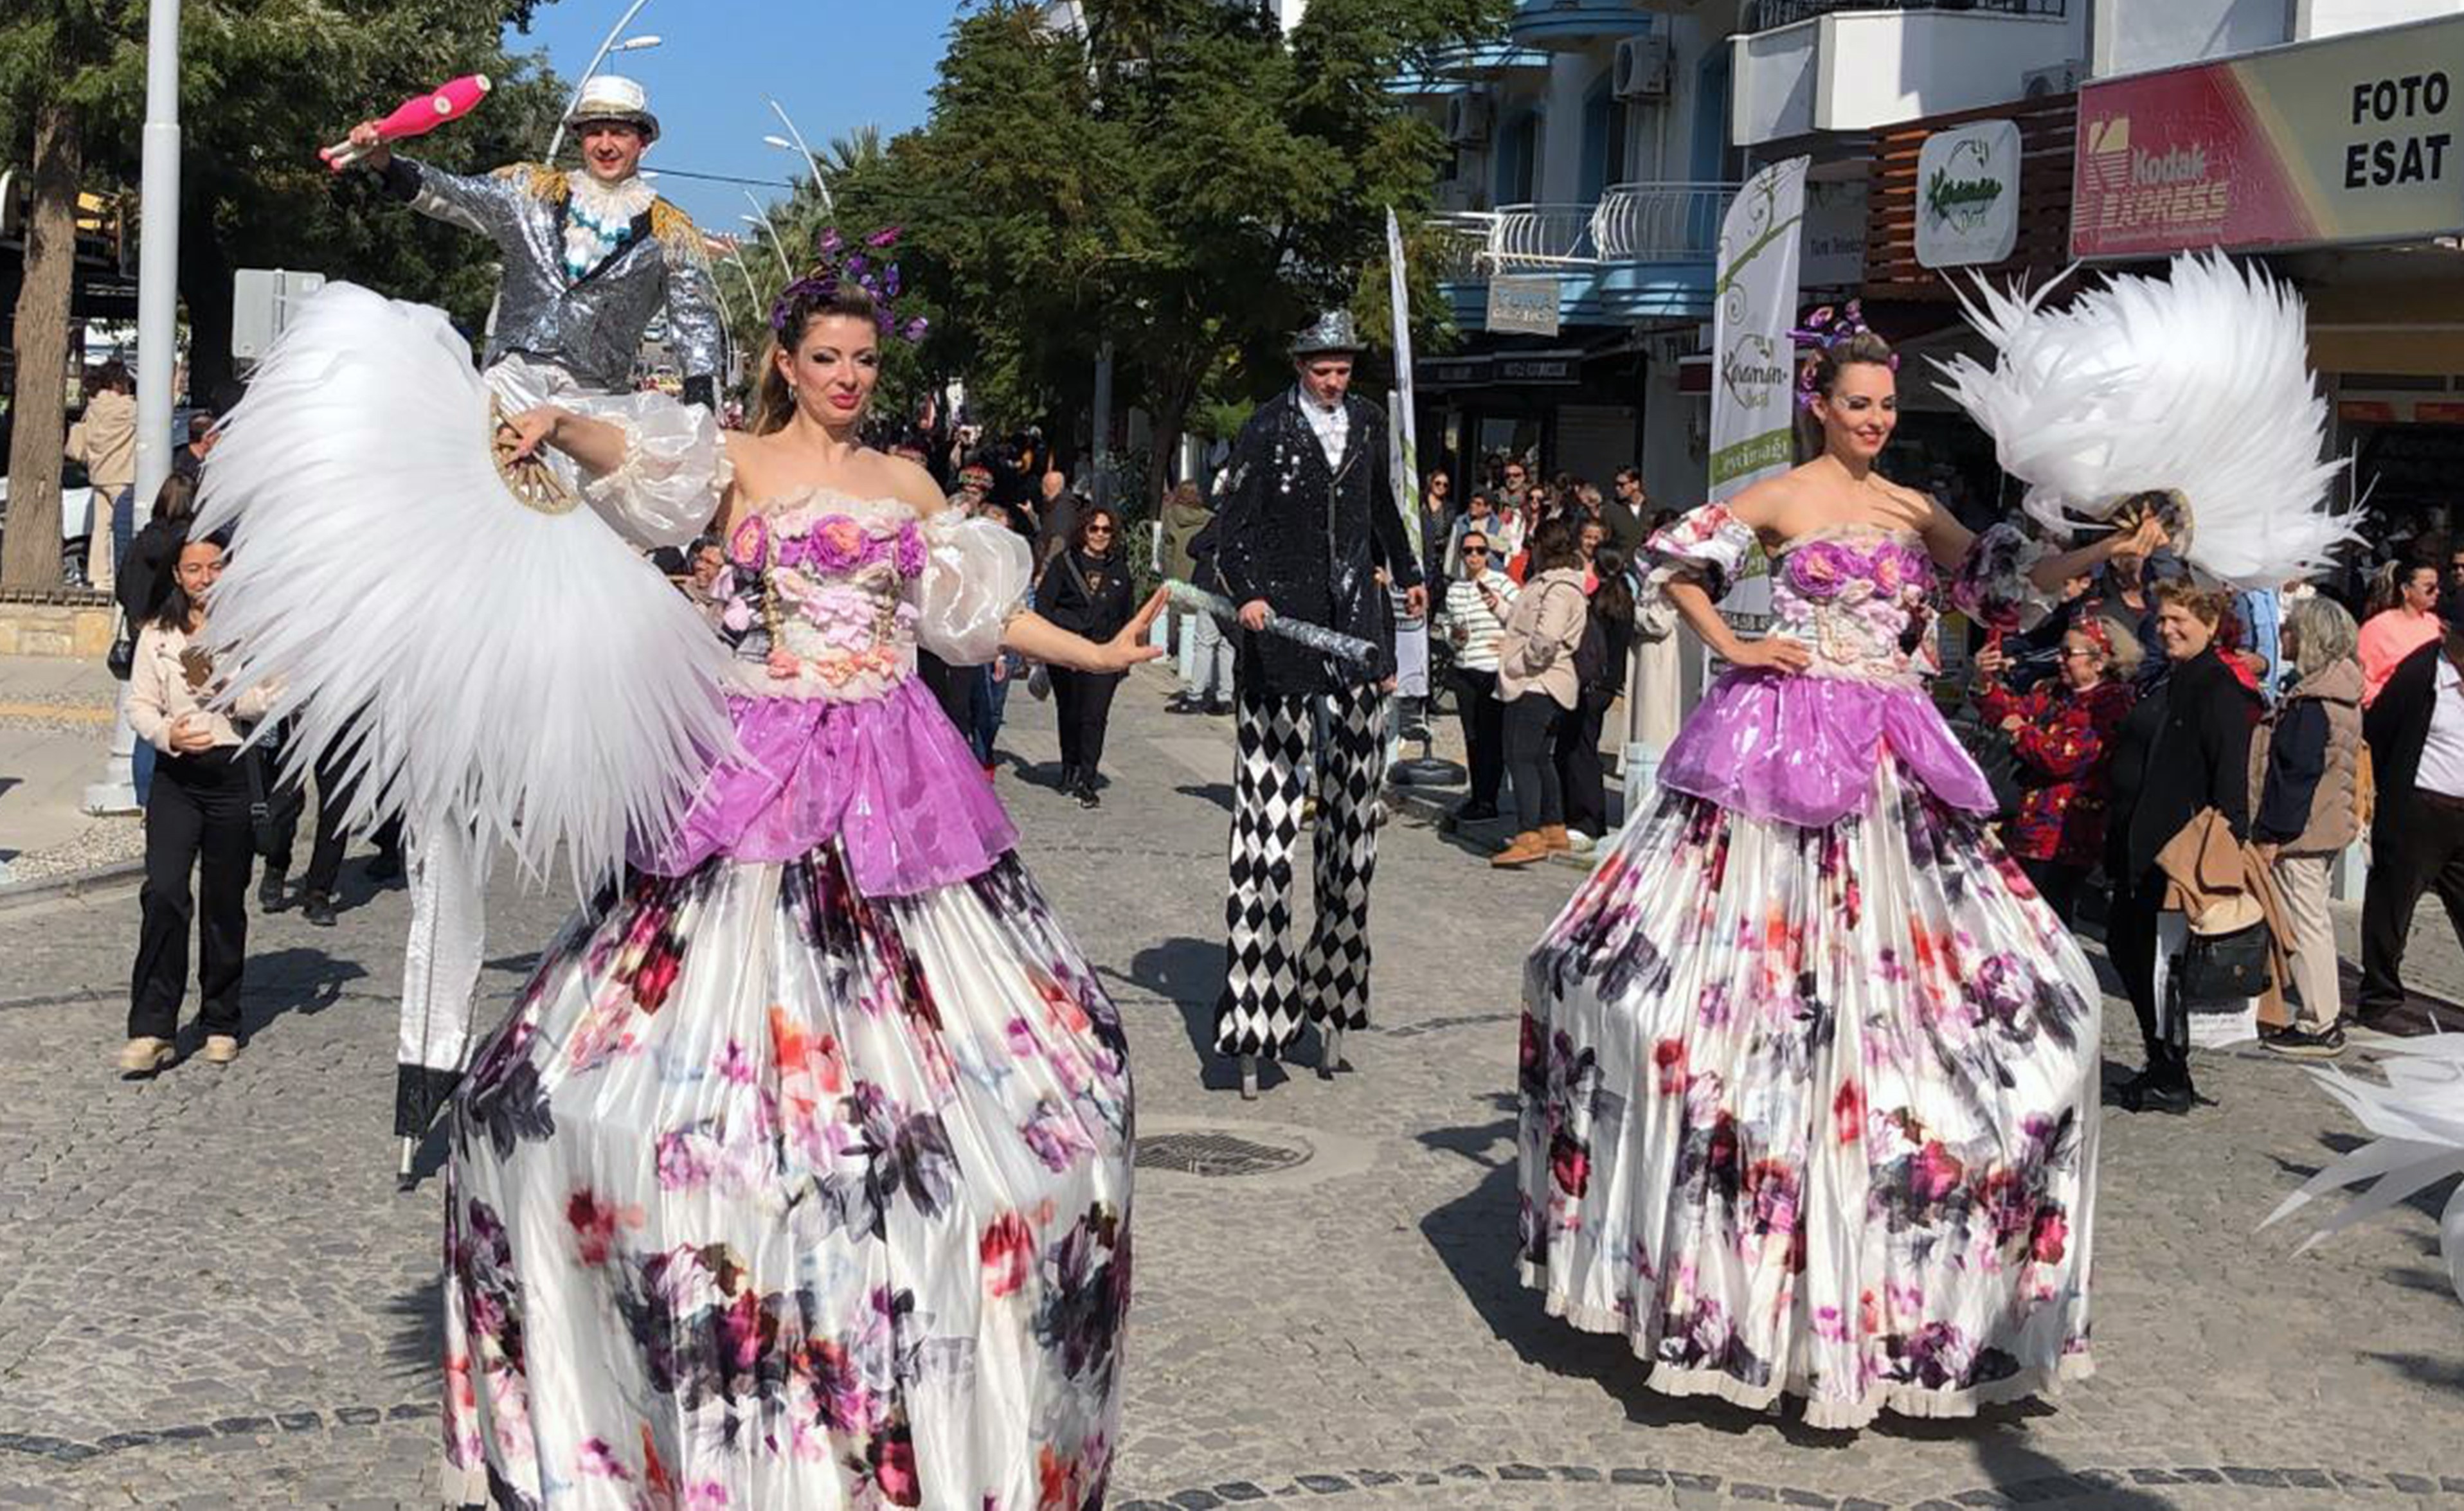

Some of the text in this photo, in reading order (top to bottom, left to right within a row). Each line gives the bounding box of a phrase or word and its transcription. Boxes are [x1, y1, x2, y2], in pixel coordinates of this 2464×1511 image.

[2353, 71, 2449, 125] FOTO
[2130, 143, 2205, 184] Kodak
[2345, 134, 2451, 189] ESAT
[2100, 182, 2229, 227] EXPRESS
